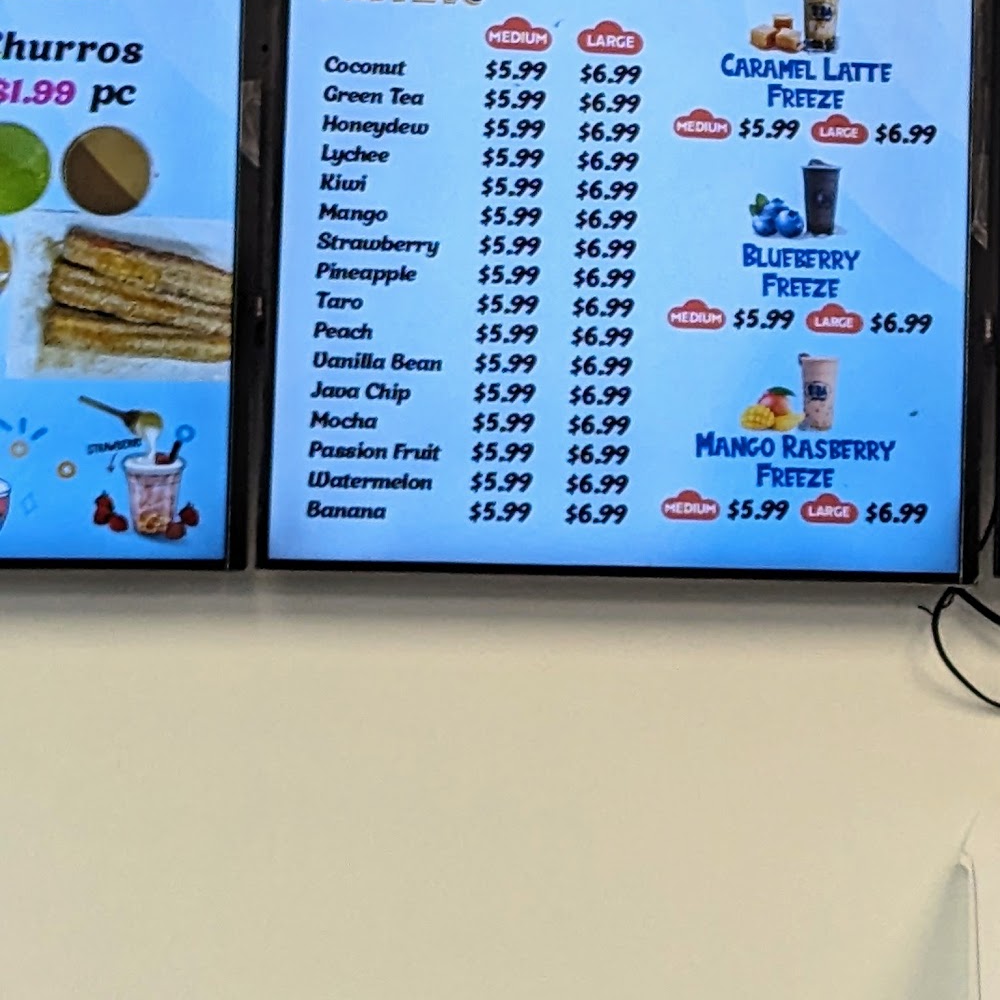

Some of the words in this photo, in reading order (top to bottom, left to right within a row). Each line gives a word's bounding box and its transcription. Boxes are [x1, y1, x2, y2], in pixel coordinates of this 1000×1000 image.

[324, 57, 406, 76] Coconut
[484, 60, 548, 81] $5.99
[580, 64, 642, 85] $6.99
[89, 84, 136, 112] pc
[323, 86, 382, 106] Green
[391, 88, 424, 106] Tea
[322, 116, 429, 138] Honeydew
[313, 352, 384, 370] Vanilla
[392, 354, 442, 371] Bean
[311, 381, 361, 399] Java
[365, 382, 411, 405] Chip
[309, 441, 387, 459] Passion
[393, 444, 441, 461] Fruit
